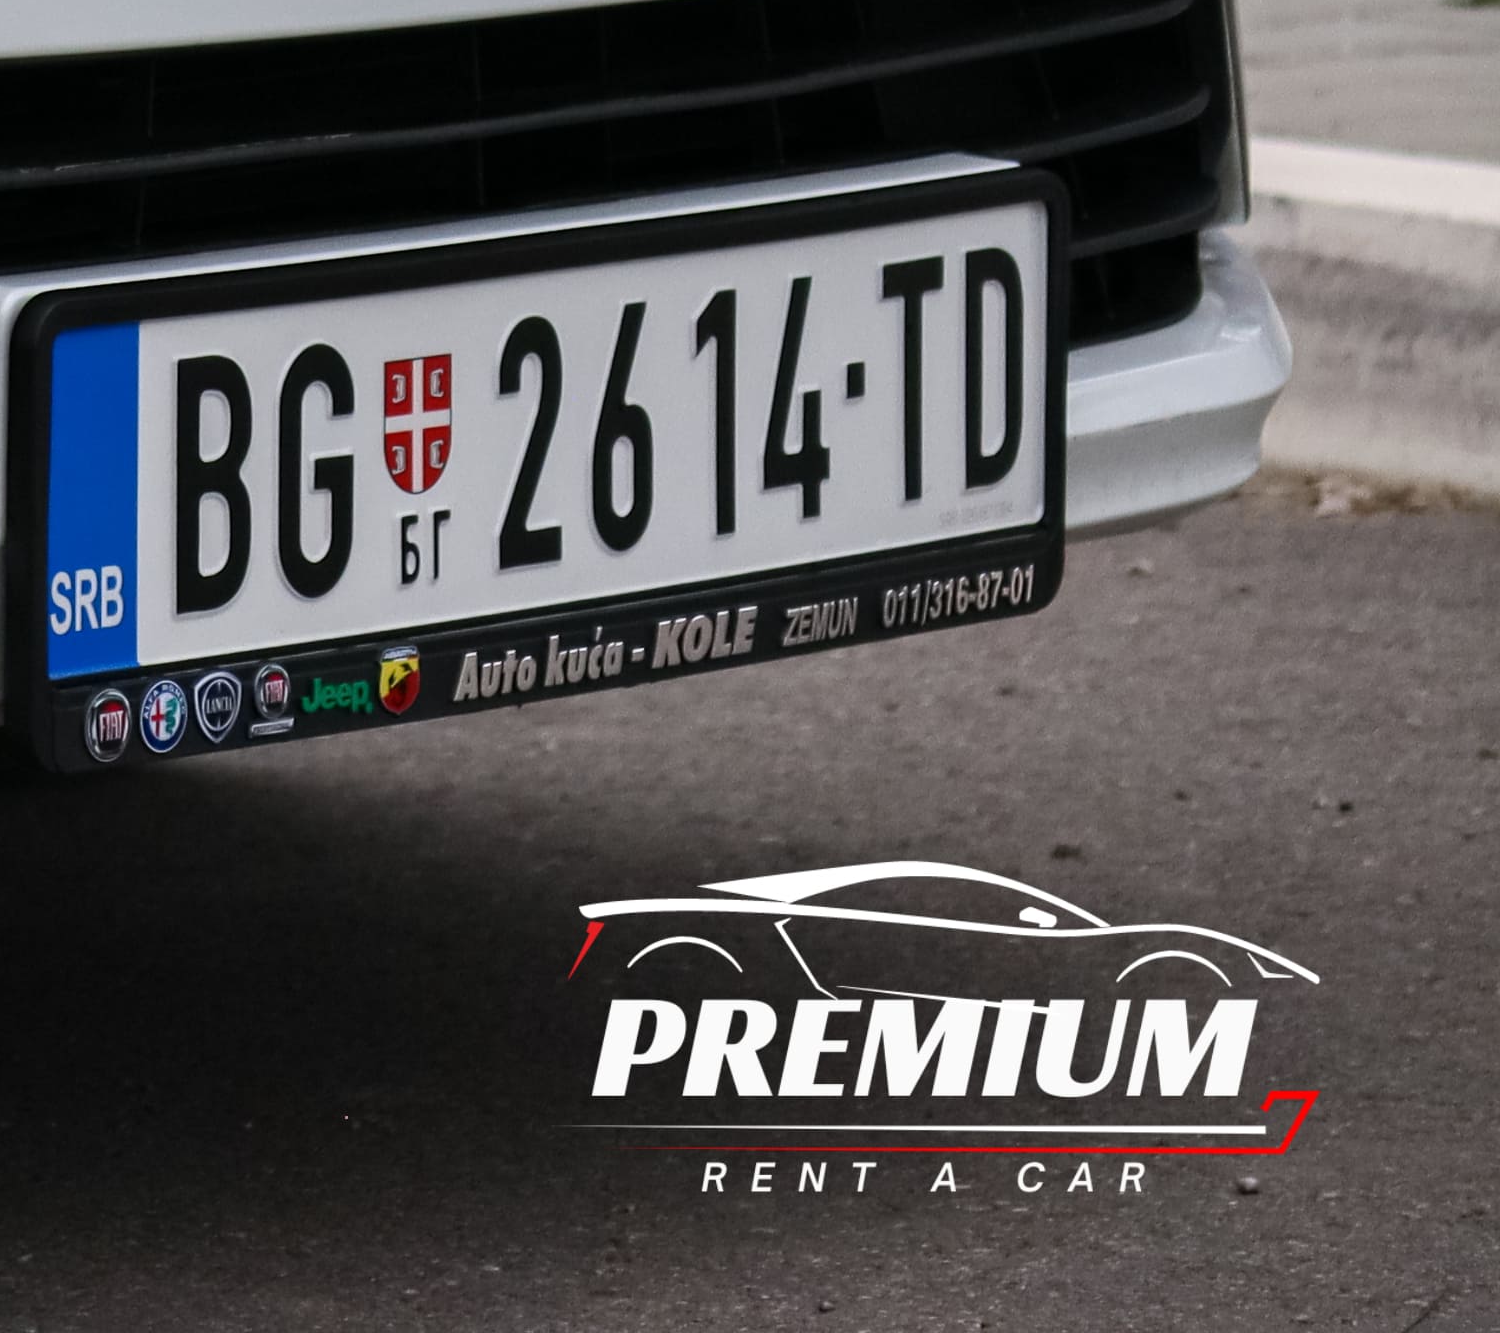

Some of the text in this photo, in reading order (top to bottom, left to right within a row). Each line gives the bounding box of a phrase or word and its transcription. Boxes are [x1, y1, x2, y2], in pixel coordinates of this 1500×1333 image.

[174, 343, 356, 616] BG
[400, 509, 453, 586] БГ
[48, 564, 125, 637] SRB
[453, 650, 537, 703] Auto
[544, 626, 623, 687] kuća
[651, 605, 759, 671] KOLE
[782, 596, 859, 648] ZEMUN
[882, 564, 1036, 629] 011/316-87-01
[99, 710, 125, 743] FIAT
